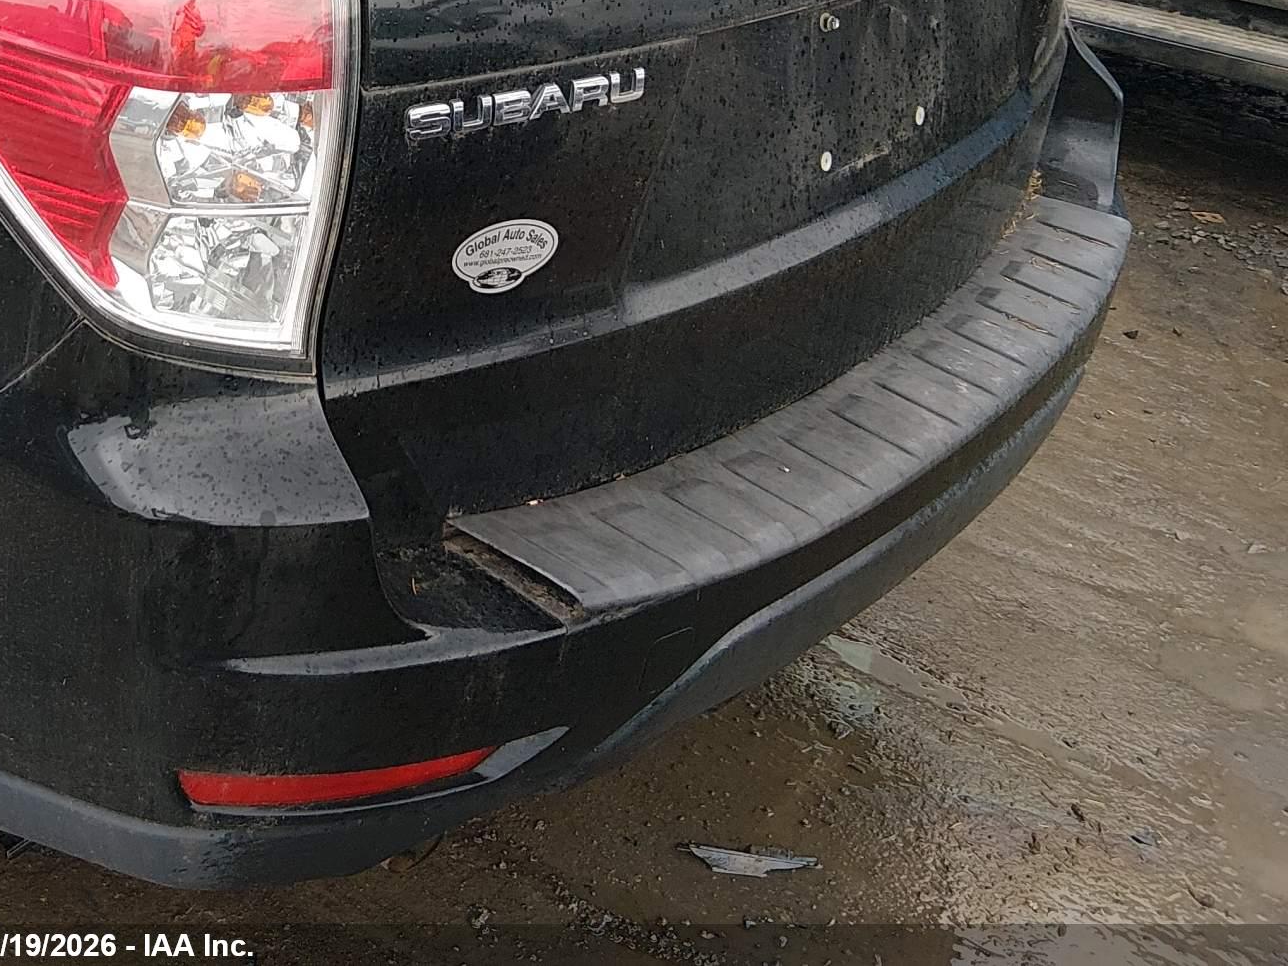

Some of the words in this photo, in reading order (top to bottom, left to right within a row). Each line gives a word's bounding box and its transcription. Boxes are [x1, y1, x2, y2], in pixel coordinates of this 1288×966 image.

[405, 66, 645, 141] SUBARU
[465, 230, 501, 257] Global
[502, 228, 526, 241] Auto
[525, 228, 548, 250] Sales
